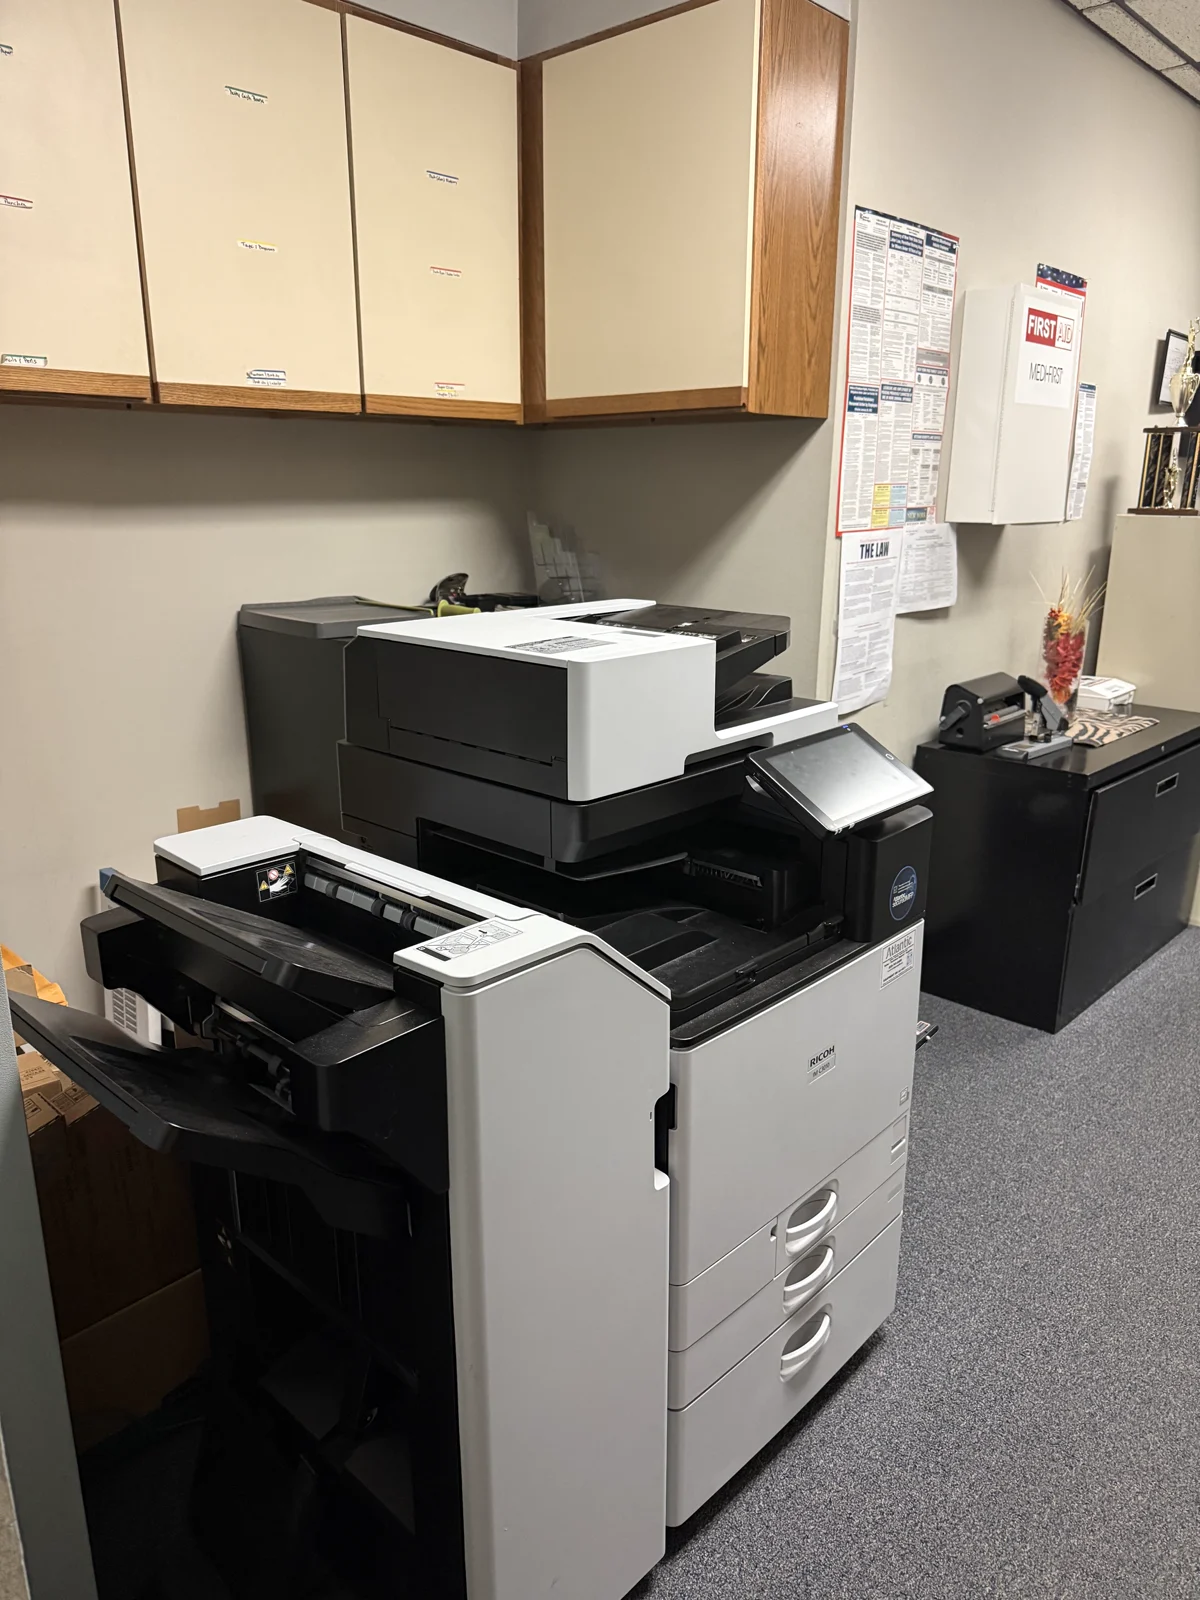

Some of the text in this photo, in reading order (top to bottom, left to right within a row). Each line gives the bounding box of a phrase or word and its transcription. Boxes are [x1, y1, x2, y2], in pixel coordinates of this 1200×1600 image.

[1028, 315, 1073, 343] FIRST AID
[1029, 362, 1063, 384] MEDI-FIRST
[860, 541, 890, 560] THE LAW
[886, 936, 913, 960] Atlantic
[810, 1045, 835, 1068] RICOH
